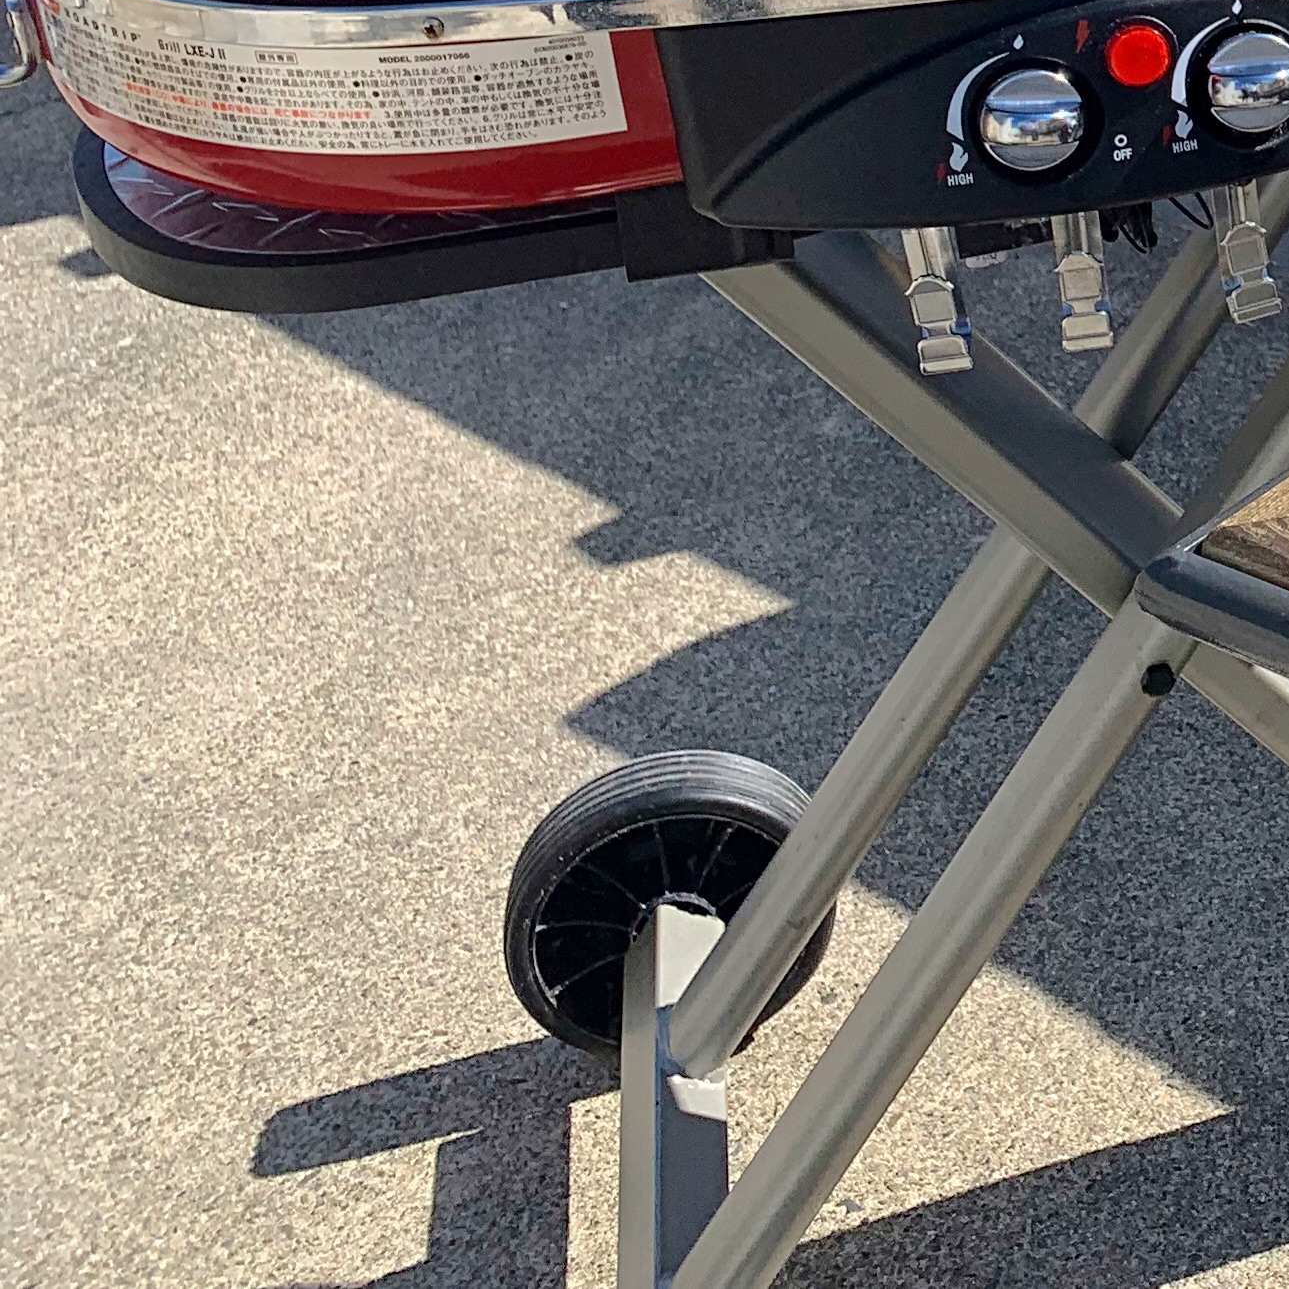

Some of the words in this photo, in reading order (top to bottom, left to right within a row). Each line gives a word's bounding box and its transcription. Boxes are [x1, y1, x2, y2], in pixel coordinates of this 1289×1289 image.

[158, 38, 181, 54] Grill
[378, 55, 412, 64] MODEL
[1172, 138, 1199, 154] HIGH
[1113, 148, 1133, 161] OFF
[947, 173, 974, 187] HIGH
